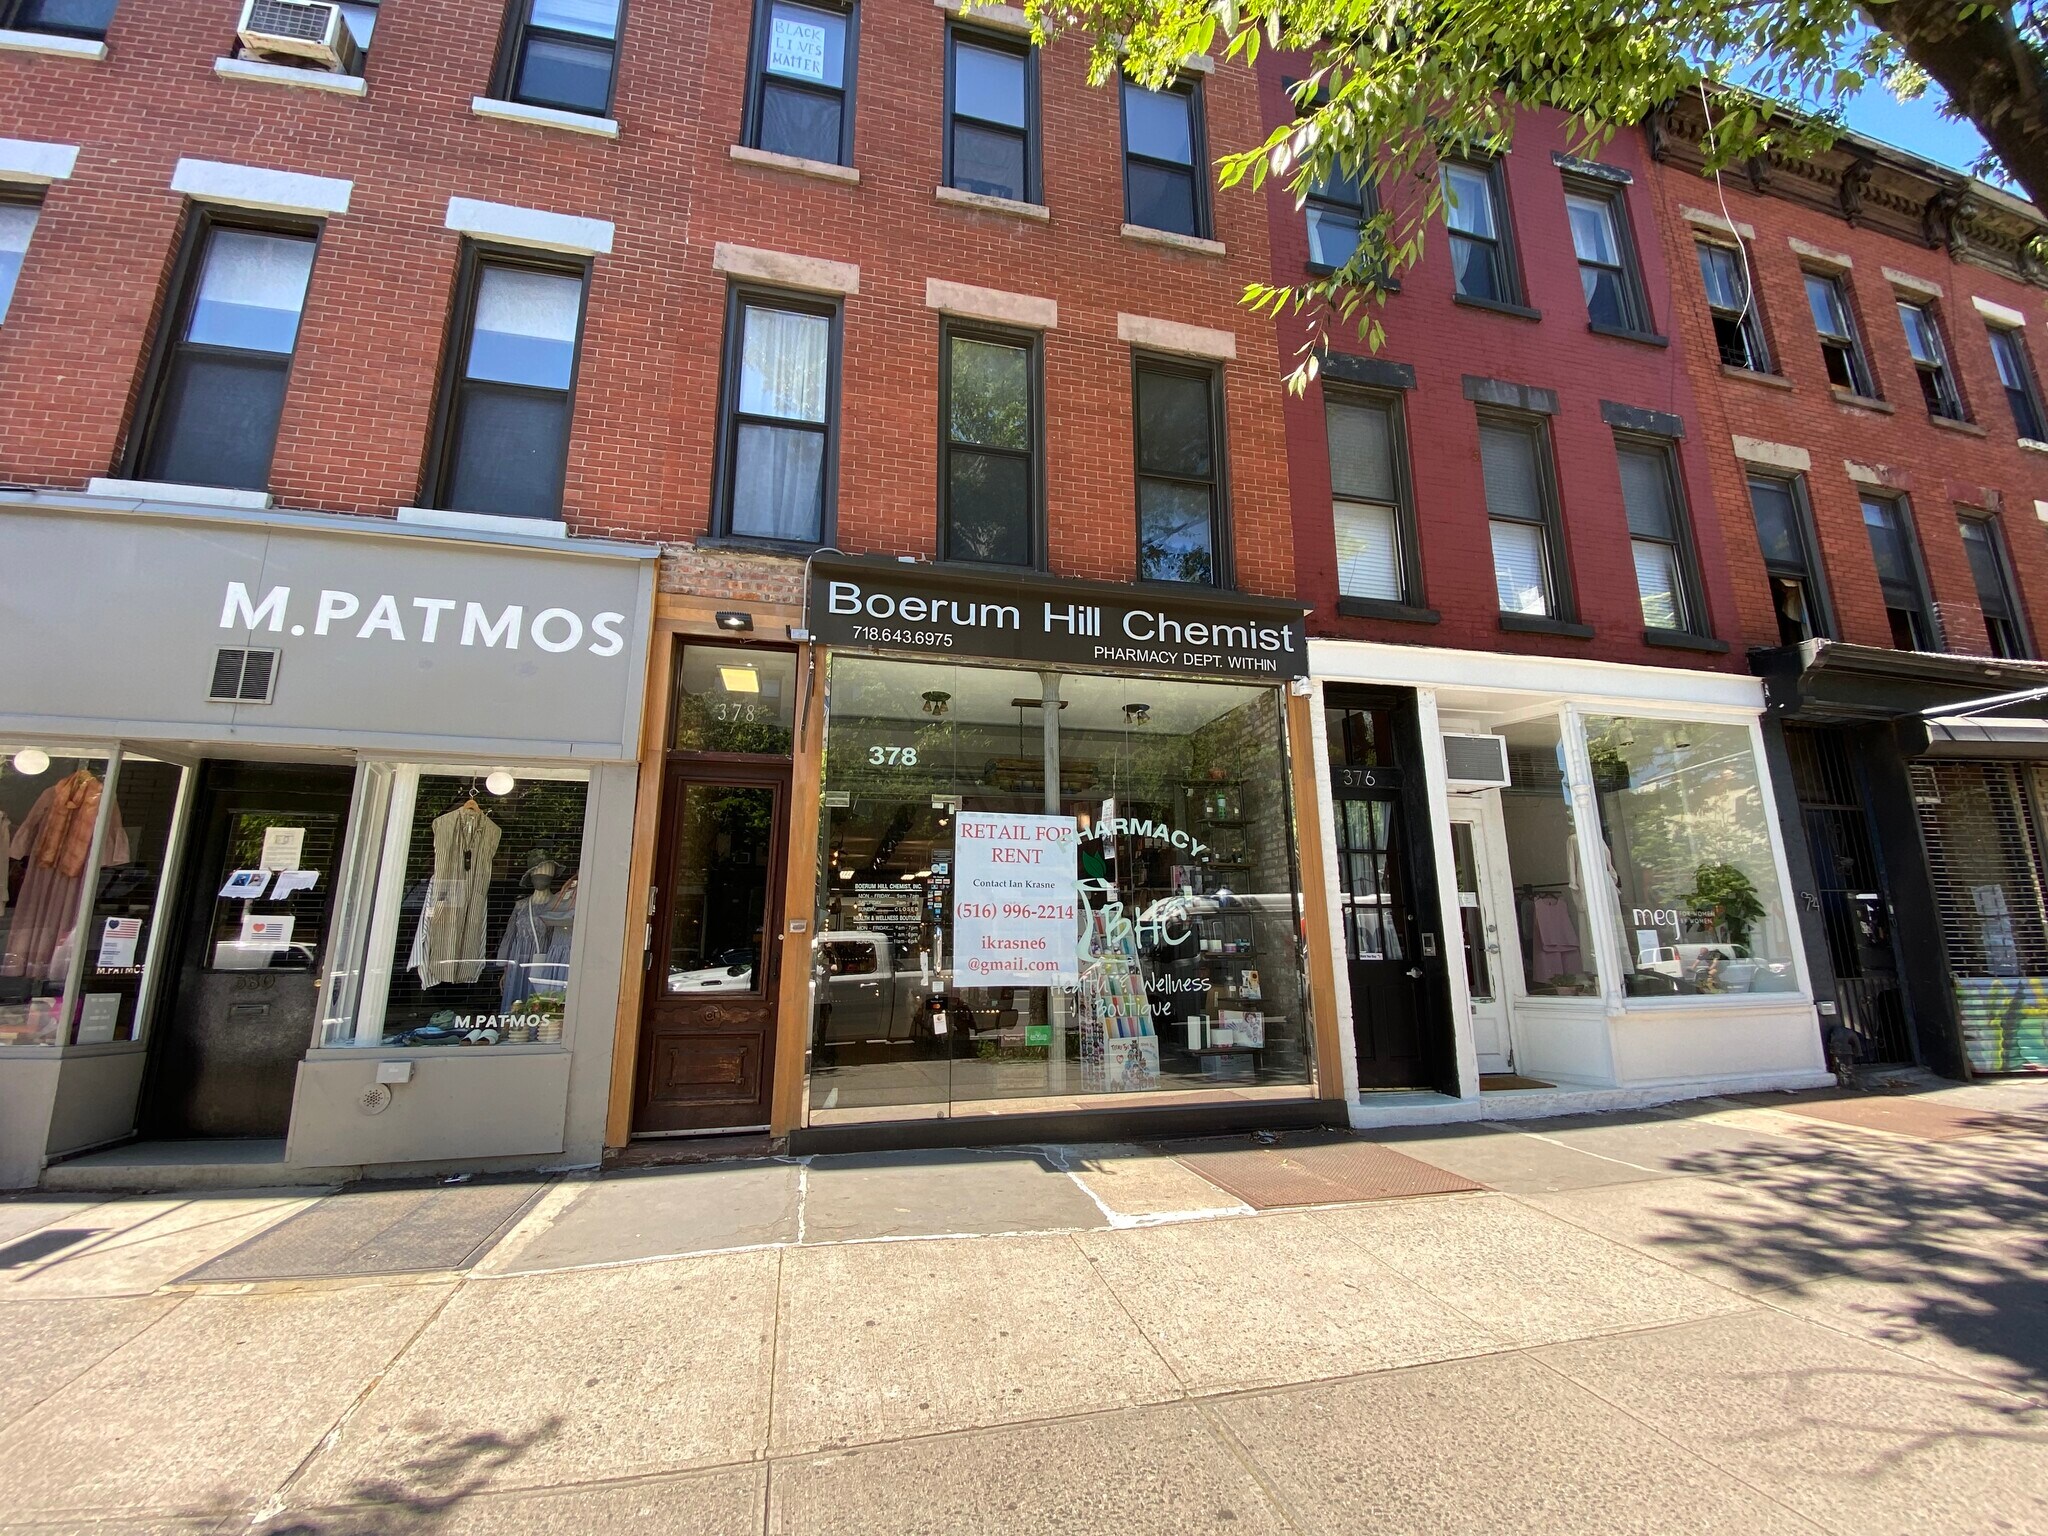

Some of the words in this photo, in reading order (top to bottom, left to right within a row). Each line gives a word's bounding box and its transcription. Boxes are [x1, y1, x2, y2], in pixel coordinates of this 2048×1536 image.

[775, 20, 821, 40] BLACK
[772, 52, 820, 73] MATTER
[218, 581, 626, 657] M.PATMOS
[828, 581, 1020, 630] Boerum
[1044, 601, 1100, 637] Hill
[1122, 609, 1295, 653] Chemist
[853, 625, 953, 647] 718.643.6975
[1094, 646, 1178, 665] PHARMACY
[1183, 652, 1223, 668] DEPT.
[1227, 655, 1277, 671] WITHIN
[717, 703, 755, 722] 378
[868, 746, 917, 766] 378
[1343, 769, 1376, 786] 376
[961, 823, 1031, 840] RETAIL
[1035, 826, 1073, 842] FOR
[991, 847, 1044, 864] RENT
[973, 878, 1007, 888] Contact
[1009, 879, 1023, 888] Ian
[1025, 880, 1056, 889] Krasne
[957, 903, 997, 919] (516)
[1002, 903, 1074, 919] 996-2214
[1632, 908, 1681, 941] meg
[981, 935, 1046, 950] ikrasne6
[968, 956, 1060, 975] @gmail.com
[1143, 971, 1212, 995] Wellness
[454, 1014, 551, 1029] M.PATMOS
